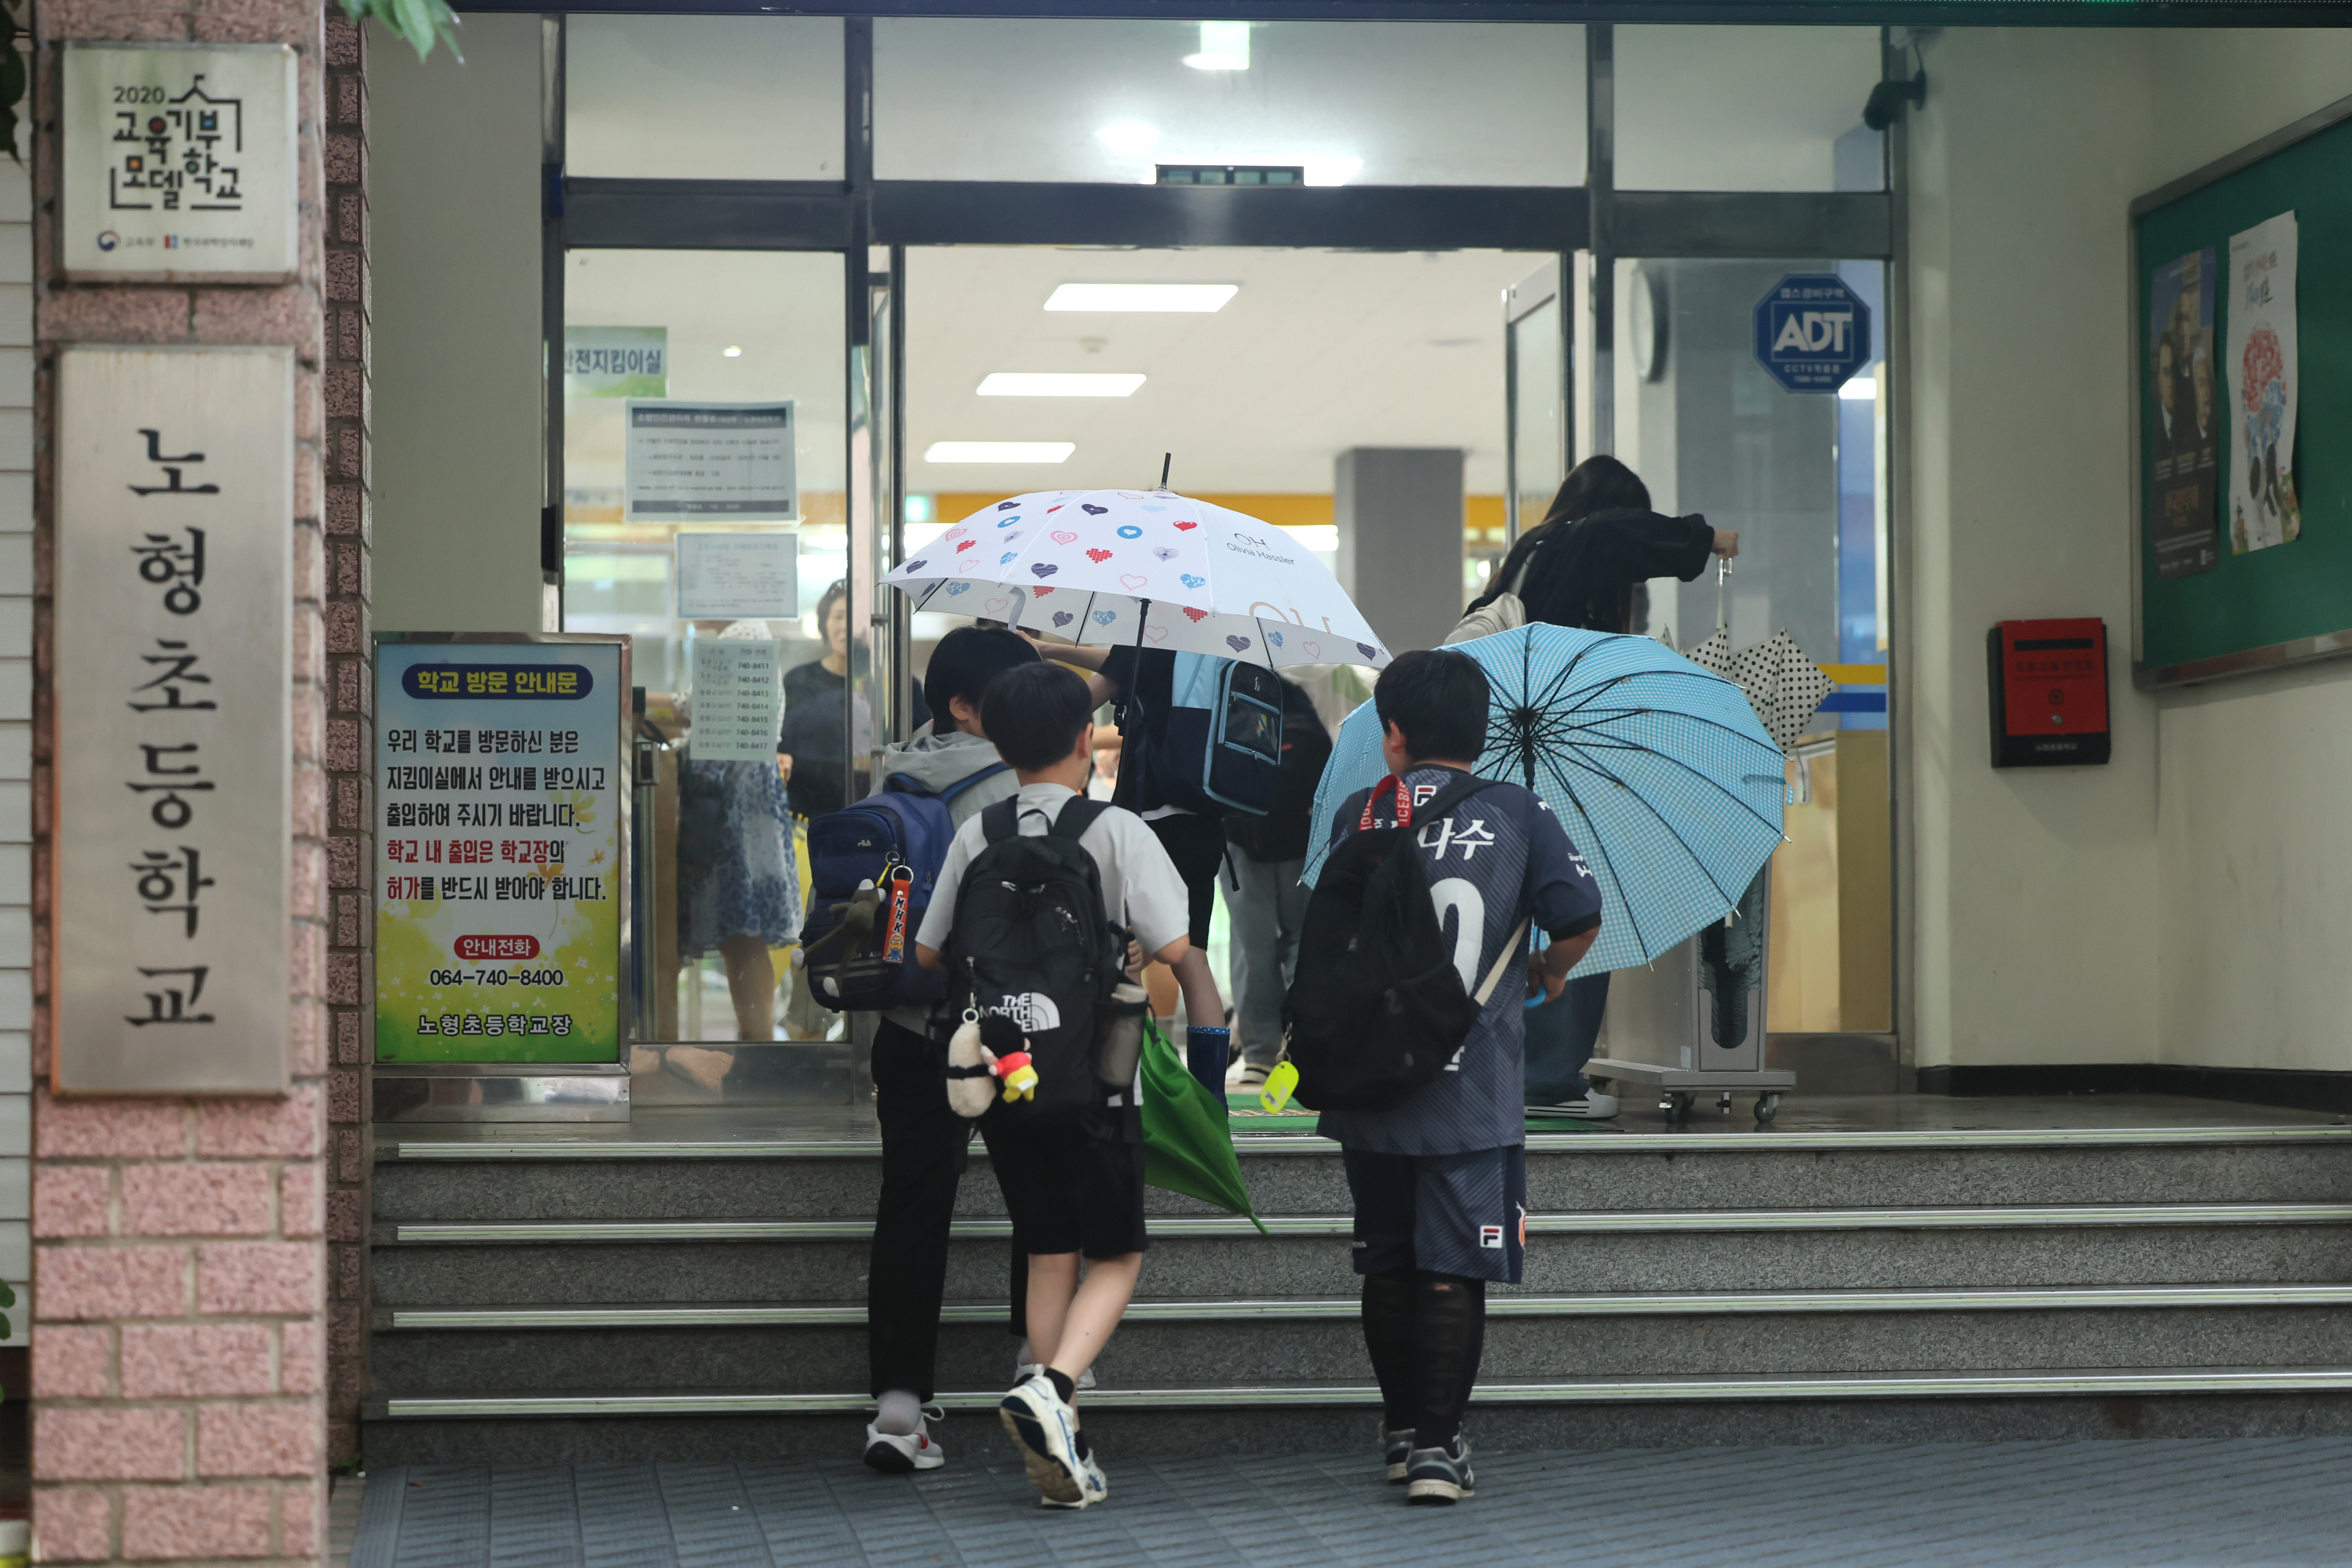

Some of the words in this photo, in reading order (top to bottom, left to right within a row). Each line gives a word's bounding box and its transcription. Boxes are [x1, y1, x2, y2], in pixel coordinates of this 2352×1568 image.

[113, 86, 165, 104] 2020
[113, 110, 222, 165] 교육기부
[122, 149, 242, 209] 모델학교
[1772, 311, 1852, 352] ADT
[1227, 542, 1255, 556] Olivia
[1256, 550, 1294, 565] Hassler
[1234, 533, 1271, 551] OH
[738, 661, 769, 670] 740-8411
[417, 671, 460, 693] 학교
[467, 671, 508, 694] 방문
[515, 671, 577, 694] 안내문
[737, 676, 769, 684] 740-8412
[124, 427, 220, 1029] 노형초등학교
[736, 715, 769, 723] 740-8415
[387, 730, 417, 753] 우리
[425, 730, 471, 753] 학교를
[478, 730, 542, 753] 방문하신
[550, 730, 579, 754] 분은
[736, 728, 768, 737] 740-8416
[736, 741, 768, 750] 740-8417
[387, 767, 482, 790] 지킴이실에서
[489, 767, 537, 790] 안내를
[544, 767, 605, 791] 받으시고
[387, 803, 450, 827] 출입하여
[457, 803, 502, 827] 주시기
[509, 803, 580, 827] 바랍니다.
[387, 840, 418, 864] 학교
[425, 840, 442, 864] 내
[449, 840, 493, 864] 출입은
[500, 840, 565, 864] 학교장의
[387, 877, 435, 901] 허가를
[442, 877, 487, 901] 반드시
[495, 877, 546, 901] 받아야
[552, 877, 607, 901] 합니다.
[893, 897, 907, 934] MHK
[463, 939, 531, 957] 안내전화
[430, 969, 564, 987] 064-740-8400
[1002, 992, 1031, 1007] THE
[417, 1014, 572, 1037] 노형초등학교장
